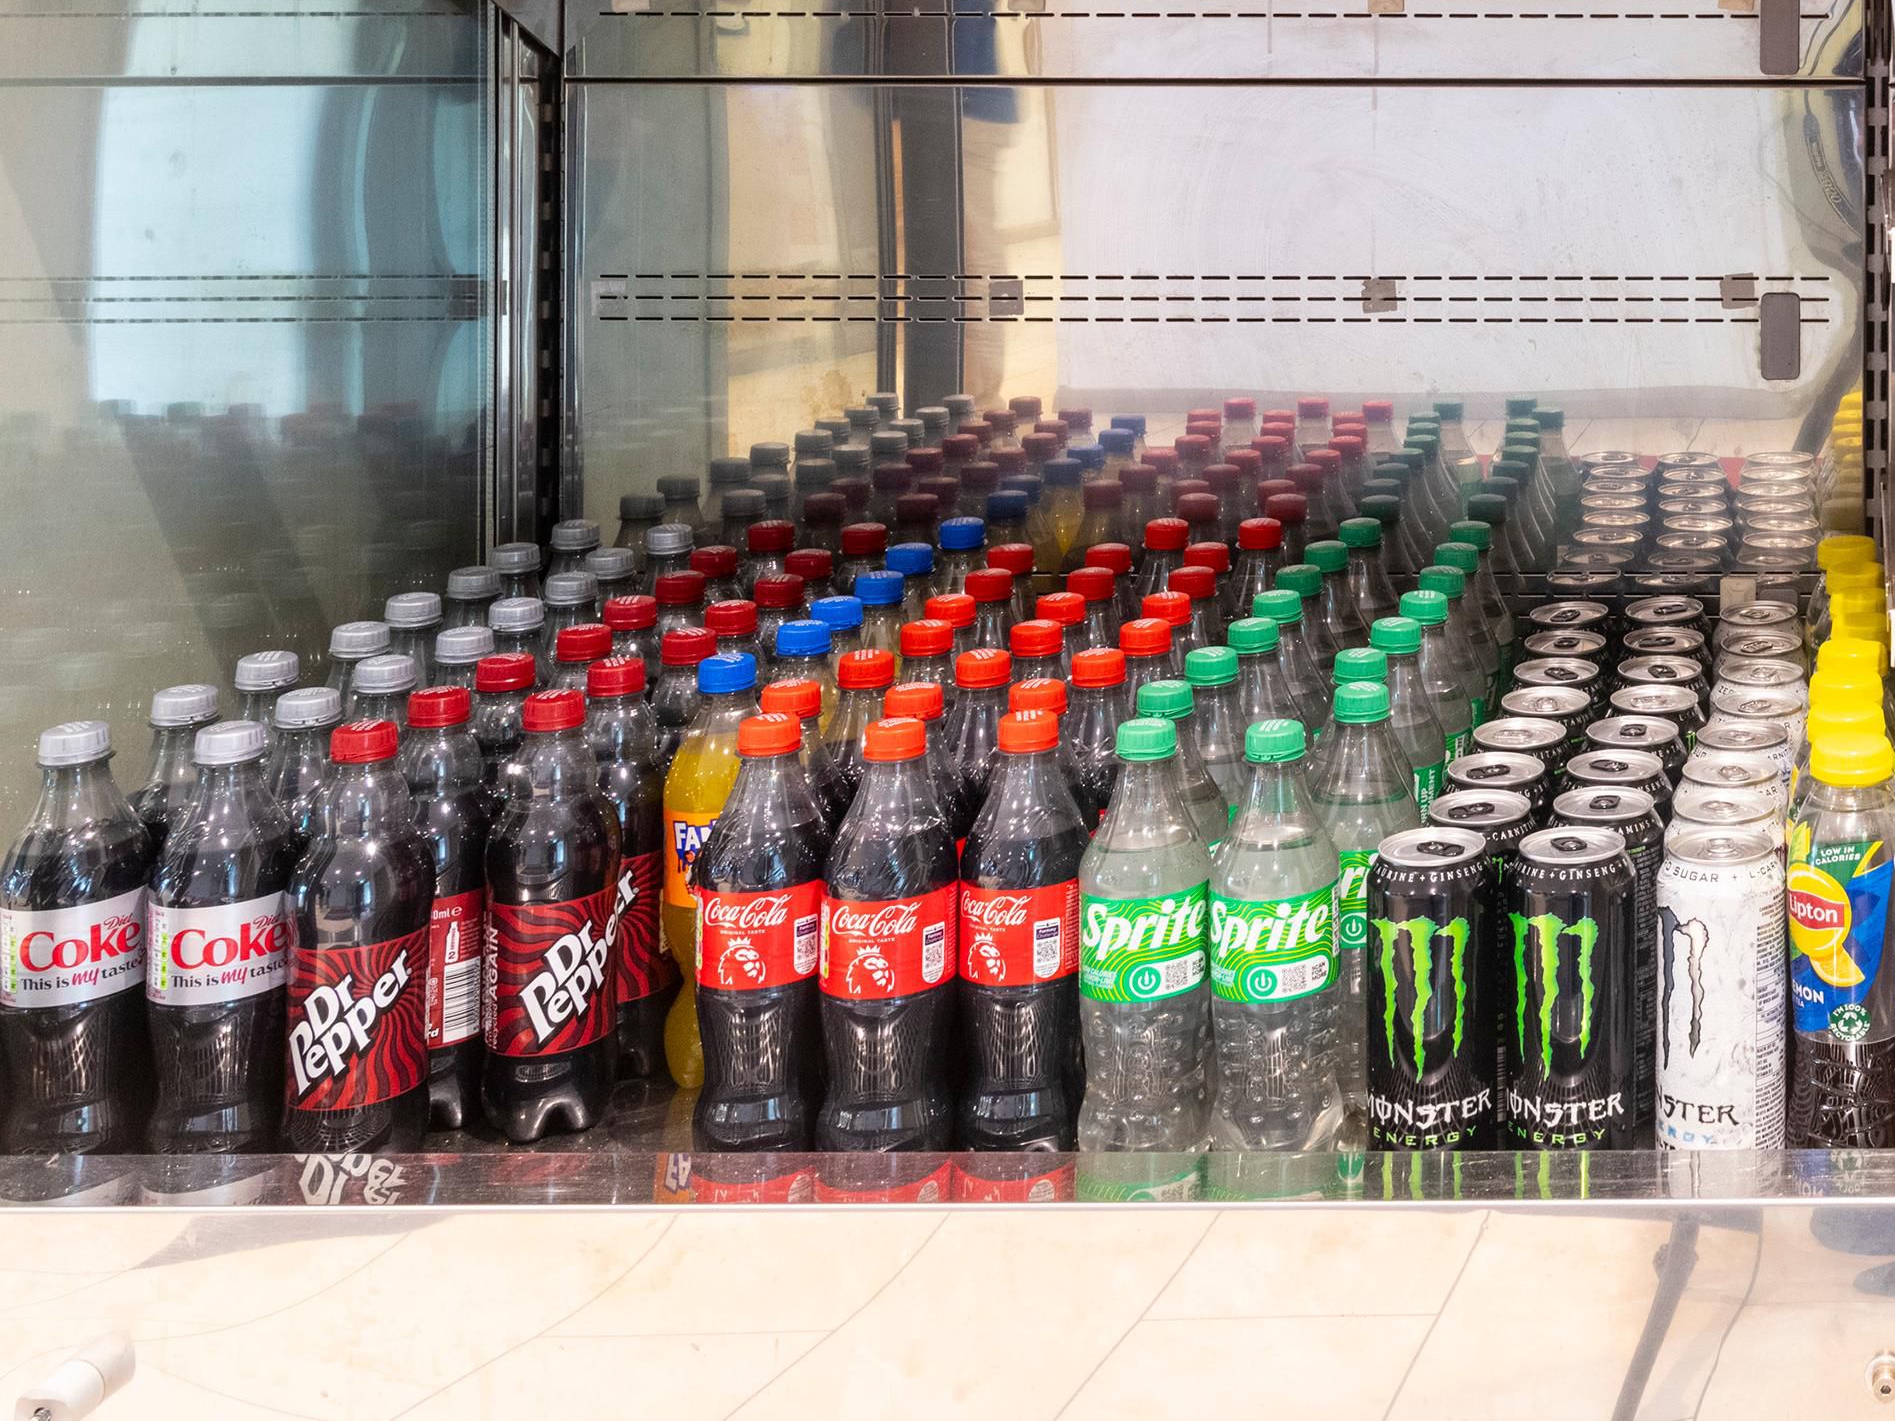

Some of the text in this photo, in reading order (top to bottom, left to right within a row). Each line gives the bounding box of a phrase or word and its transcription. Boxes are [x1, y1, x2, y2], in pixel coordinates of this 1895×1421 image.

[1559, 863, 1617, 881] GINSENG
[103, 913, 134, 929] Diet
[705, 894, 792, 928] Coca-Cola
[1083, 896, 1206, 961] Sprite
[1210, 902, 1329, 958] Sprite
[20, 921, 141, 972] Coke
[21, 962, 138, 990] This is my taste
[1311, 961, 1326, 971] SCAN
[1312, 972, 1327, 981] MORE
[304, 975, 353, 1037] Dr
[288, 949, 411, 1096] Pepper
[1373, 1126, 1476, 1147] ENERGY
